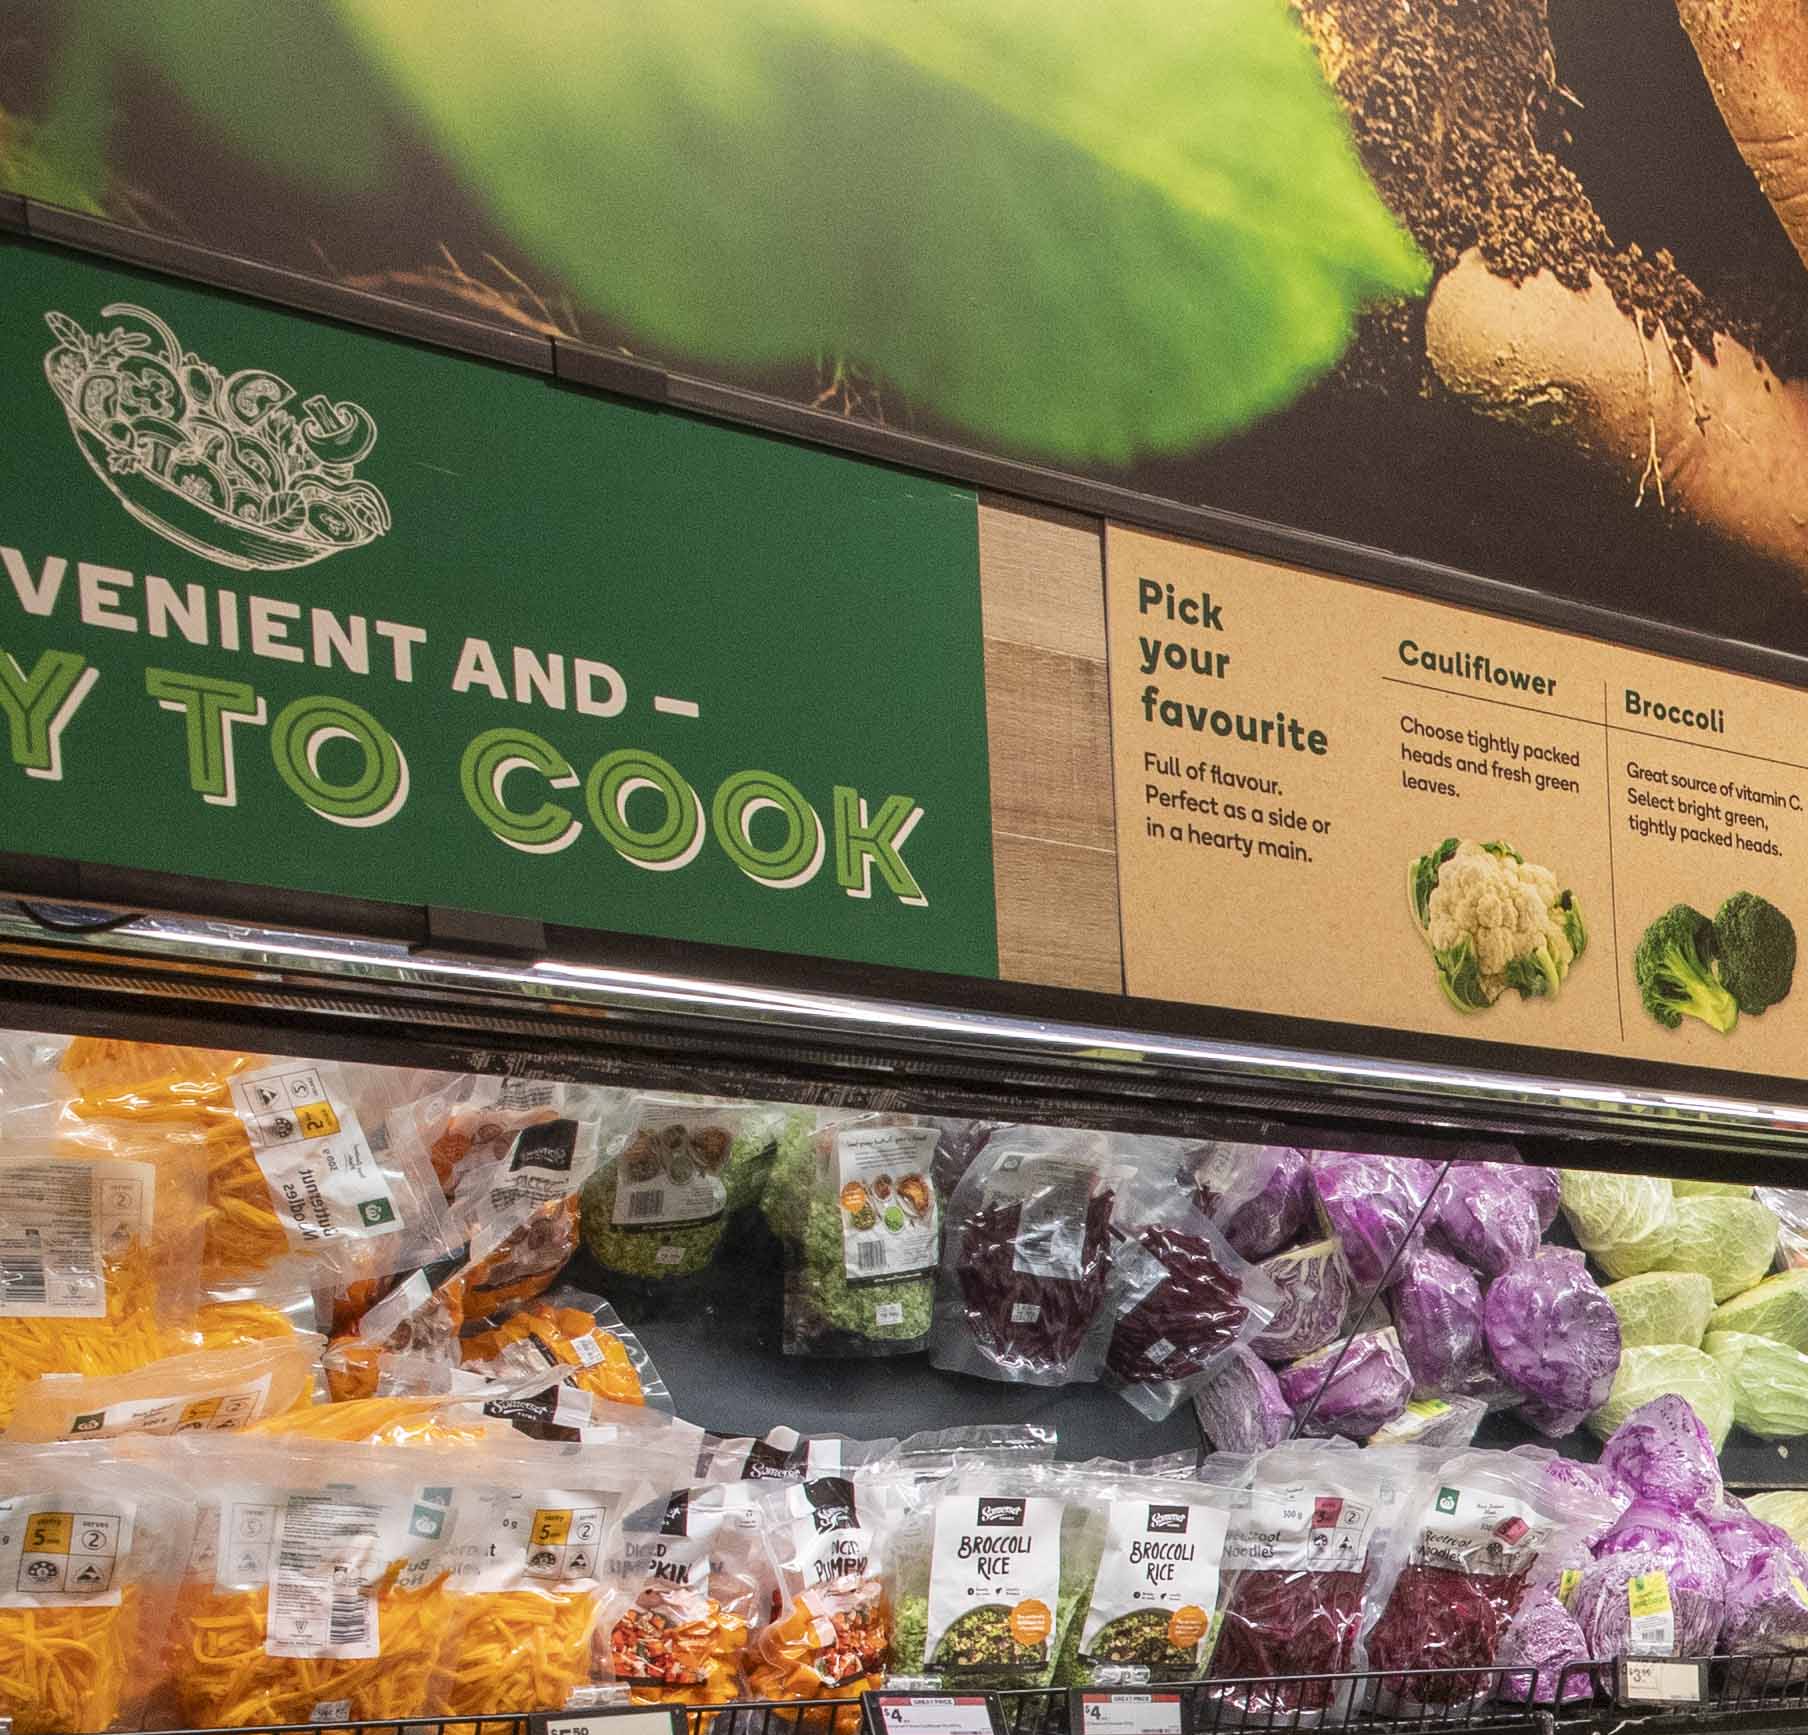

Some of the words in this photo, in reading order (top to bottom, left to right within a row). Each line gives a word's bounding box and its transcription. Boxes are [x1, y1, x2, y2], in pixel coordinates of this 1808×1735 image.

[1139, 578, 1223, 631] Pick
[452, 637, 628, 718] AND
[1139, 637, 1230, 678] your
[1399, 640, 1556, 696] Cauliflower
[1141, 686, 1328, 755] favourite
[1626, 690, 1724, 733] Broccoli
[1400, 716, 1464, 743] Choose
[1467, 730, 1519, 759] tightly
[1524, 745, 1580, 767] packed
[144, 666, 412, 828] TO
[460, 726, 929, 908] COOK
[1144, 752, 1181, 777] Full
[1186, 762, 1207, 781] of
[1210, 765, 1282, 795] flavour.
[1402, 743, 1452, 768] heads
[1456, 759, 1487, 775] and
[1492, 761, 1531, 784] fresh
[1535, 774, 1579, 793] green
[1403, 771, 1460, 797] leaves.
[1627, 762, 1668, 784] Great
[1672, 775, 1717, 794] source
[1720, 782, 1735, 798] of
[1737, 785, 1786, 807] vitamin
[1789, 795, 1803, 811] C.
[1146, 784, 1218, 815] Perfect
[1224, 804, 1246, 820] as
[1252, 809, 1263, 823] a
[1269, 808, 1307, 831] side
[1312, 820, 1331, 834] or
[1628, 788, 1674, 811] Select
[1678, 798, 1721, 821] bright
[1725, 811, 1768, 830] green,
[1147, 817, 1164, 838] in
[1170, 826, 1182, 841] a
[1188, 824, 1253, 858] hearty
[1258, 841, 1312, 862] main.
[1629, 815, 1676, 841] tightly
[1681, 828, 1732, 847] packed
[1736, 834, 1782, 856] heads.
[957, 1535, 1032, 1560] BROCCOLI
[977, 1556, 1011, 1581] RICE
[1129, 1540, 1195, 1565] BROCCOLI
[1146, 1562, 1175, 1586] RICE
